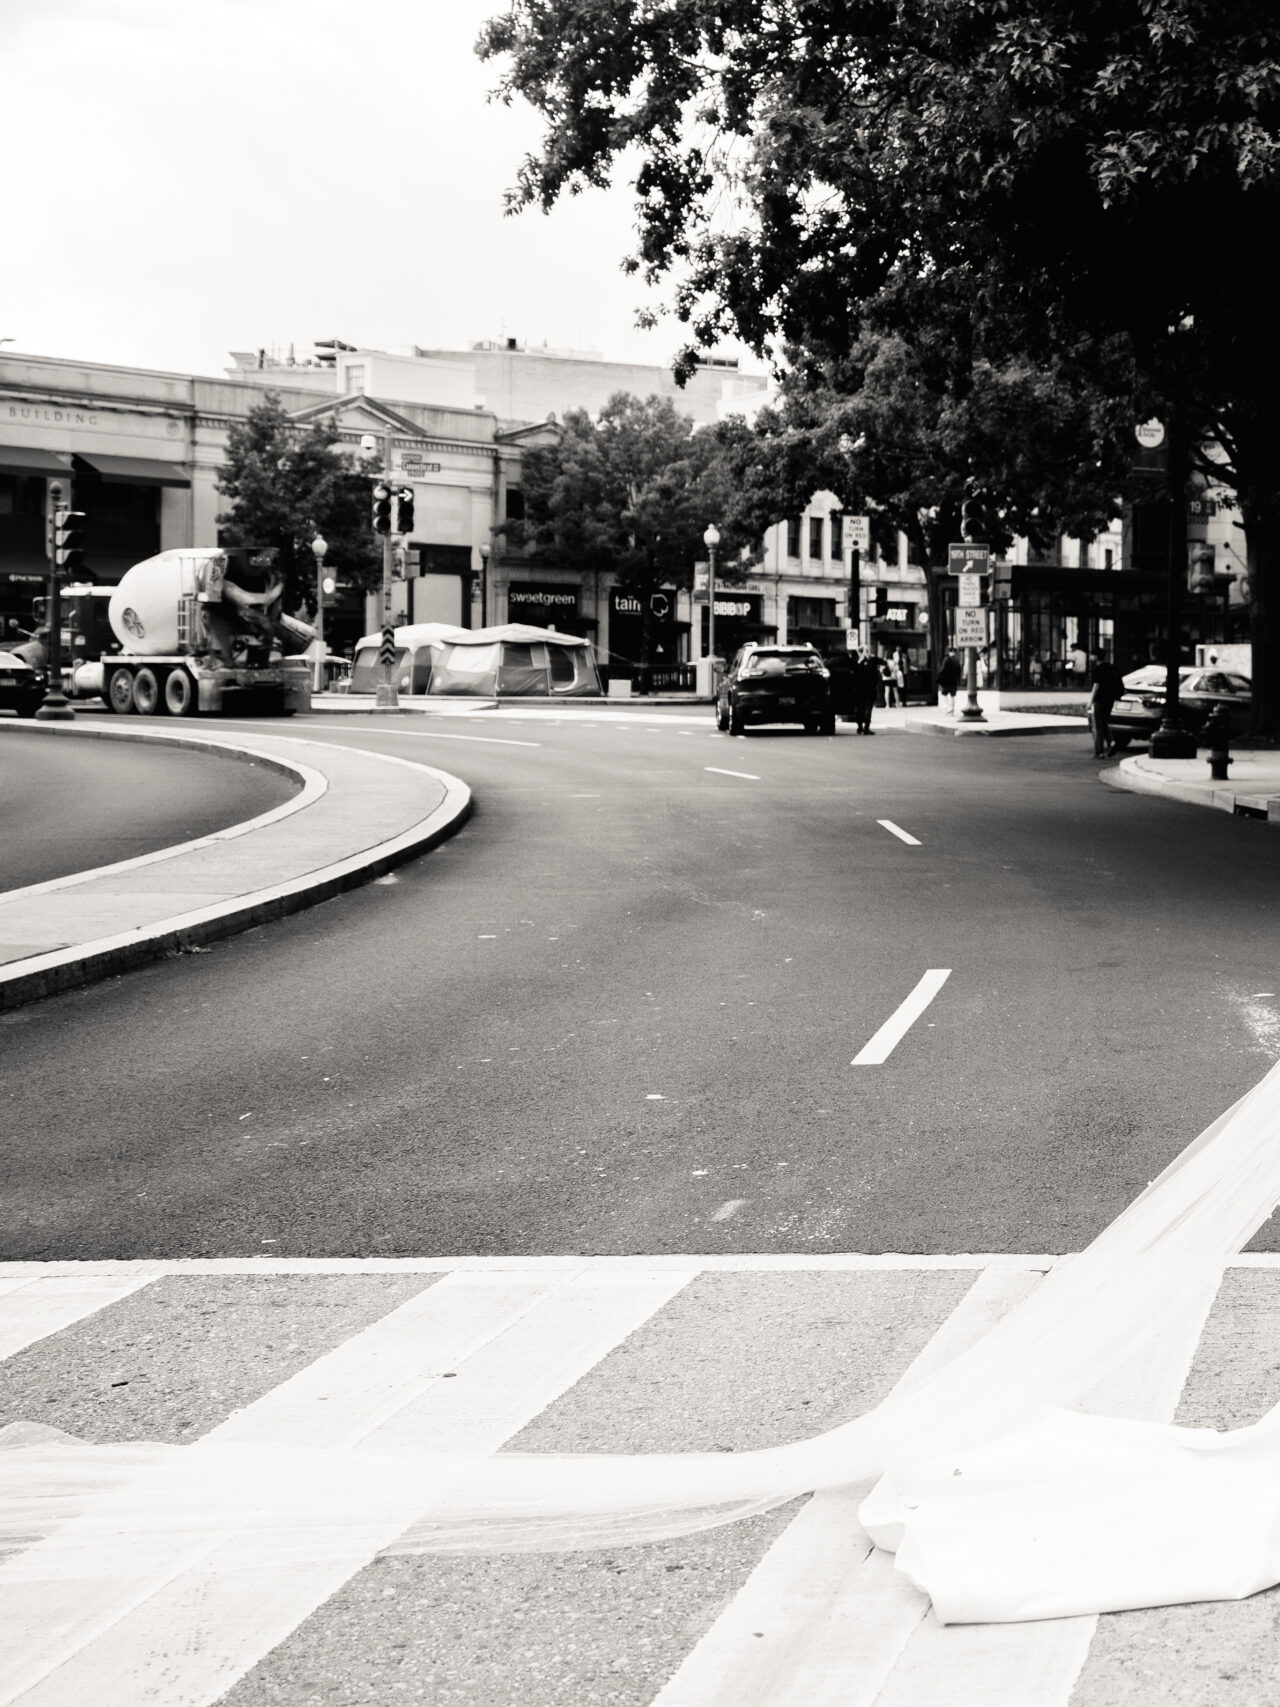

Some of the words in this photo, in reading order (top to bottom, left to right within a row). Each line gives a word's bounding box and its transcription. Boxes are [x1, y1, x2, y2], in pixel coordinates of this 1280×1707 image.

[8, 405, 98, 426] BUILDING
[966, 549, 988, 560] STREET
[510, 592, 576, 606] sweetgreen
[965, 610, 976, 618] NO
